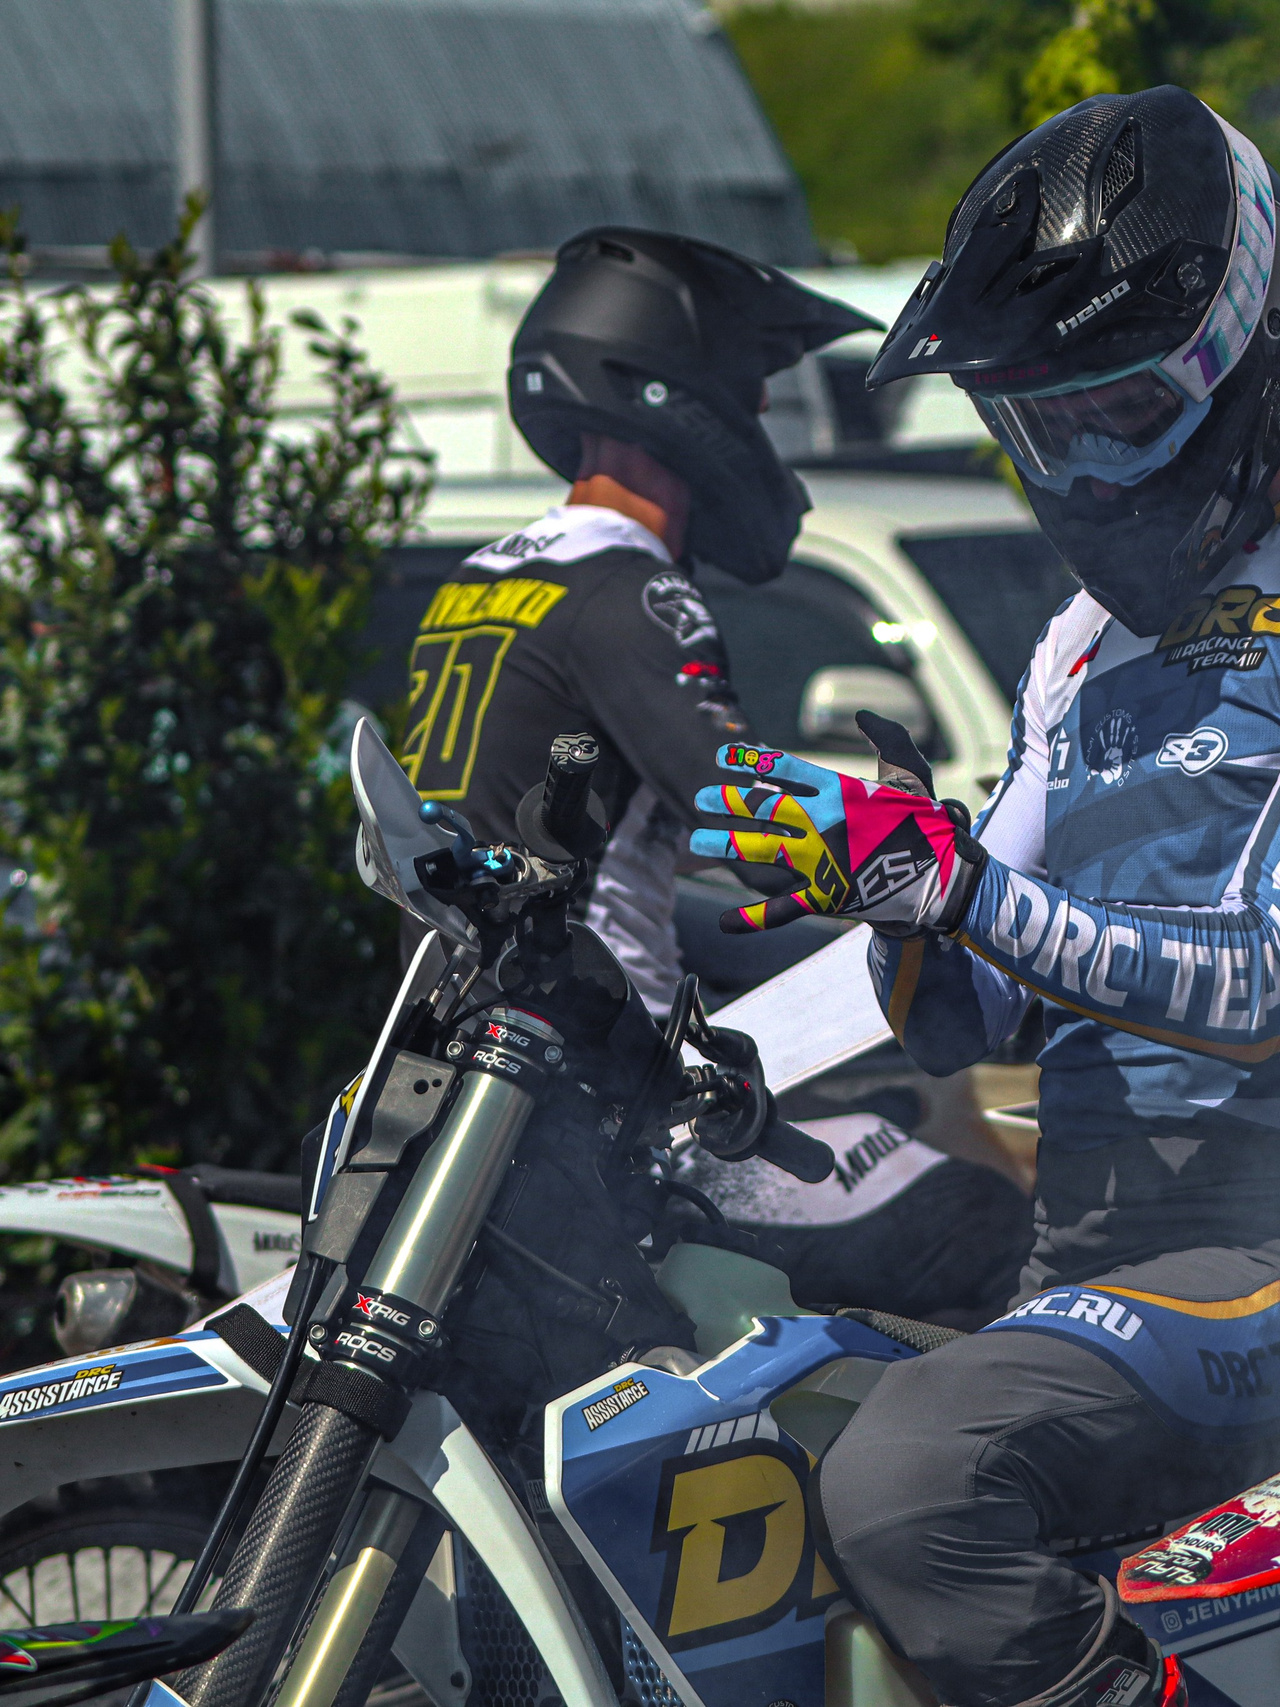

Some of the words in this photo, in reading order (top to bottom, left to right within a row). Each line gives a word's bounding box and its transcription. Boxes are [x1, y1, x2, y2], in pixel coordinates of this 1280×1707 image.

[1056, 280, 1131, 336] hebo
[1182, 636, 1252, 658] RACING
[1193, 652, 1245, 670] TEAM
[1094, 708, 1133, 733] CUSTOMS
[1047, 777, 1070, 791] ebo
[986, 870, 1141, 1007] DRC
[486, 1022, 531, 1047] XTRIG
[472, 1050, 522, 1075] ROCS
[352, 1292, 412, 1326] XTRIG
[990, 1290, 1144, 1341] RC.RU
[334, 1331, 397, 1362] ROCS
[75, 1364, 117, 1380] DRC
[1197, 1348, 1266, 1398] DRC
[614, 1377, 636, 1393] DRC
[1175, 1536, 1224, 1553] ENDURO
[1135, 1560, 1198, 1585] ПУТЬ
